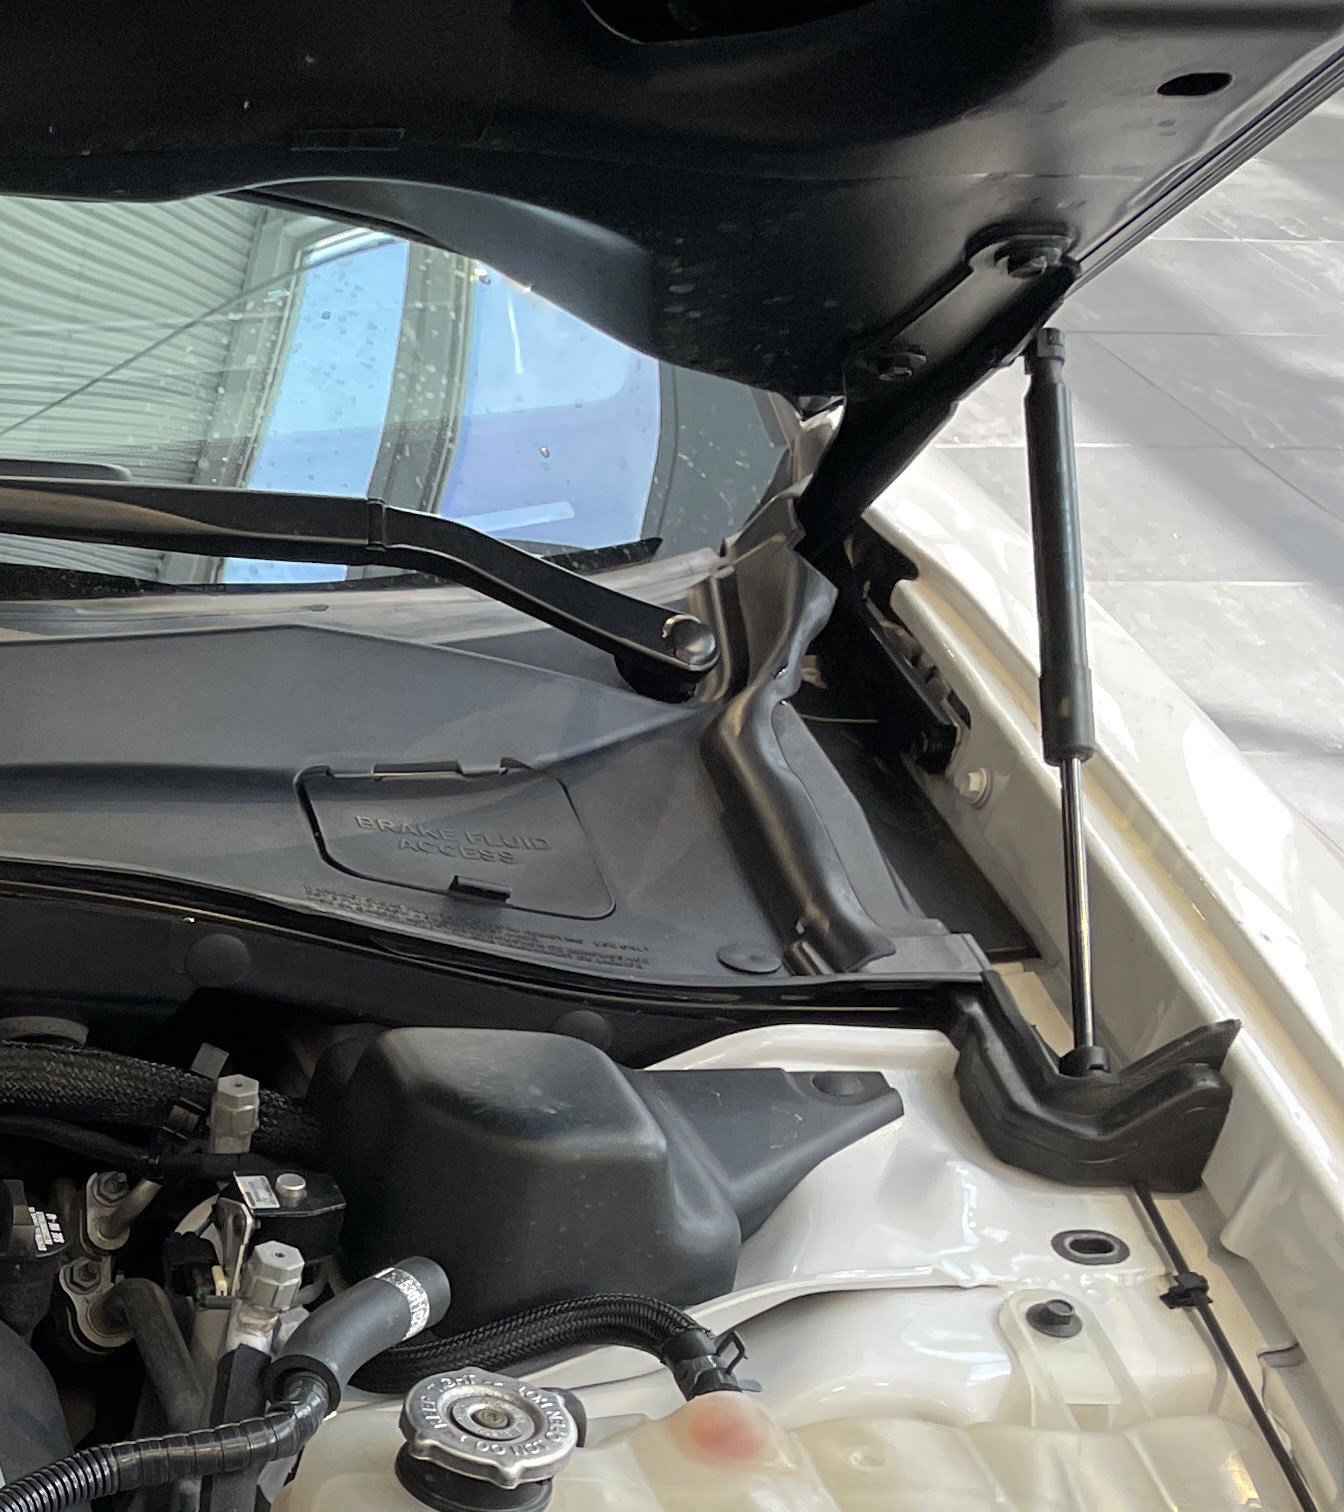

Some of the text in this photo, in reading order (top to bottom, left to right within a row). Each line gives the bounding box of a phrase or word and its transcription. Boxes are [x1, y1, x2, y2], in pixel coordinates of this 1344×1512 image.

[354, 815, 549, 851] BRAKE FLUID
[399, 837, 517, 864] ACCESS
